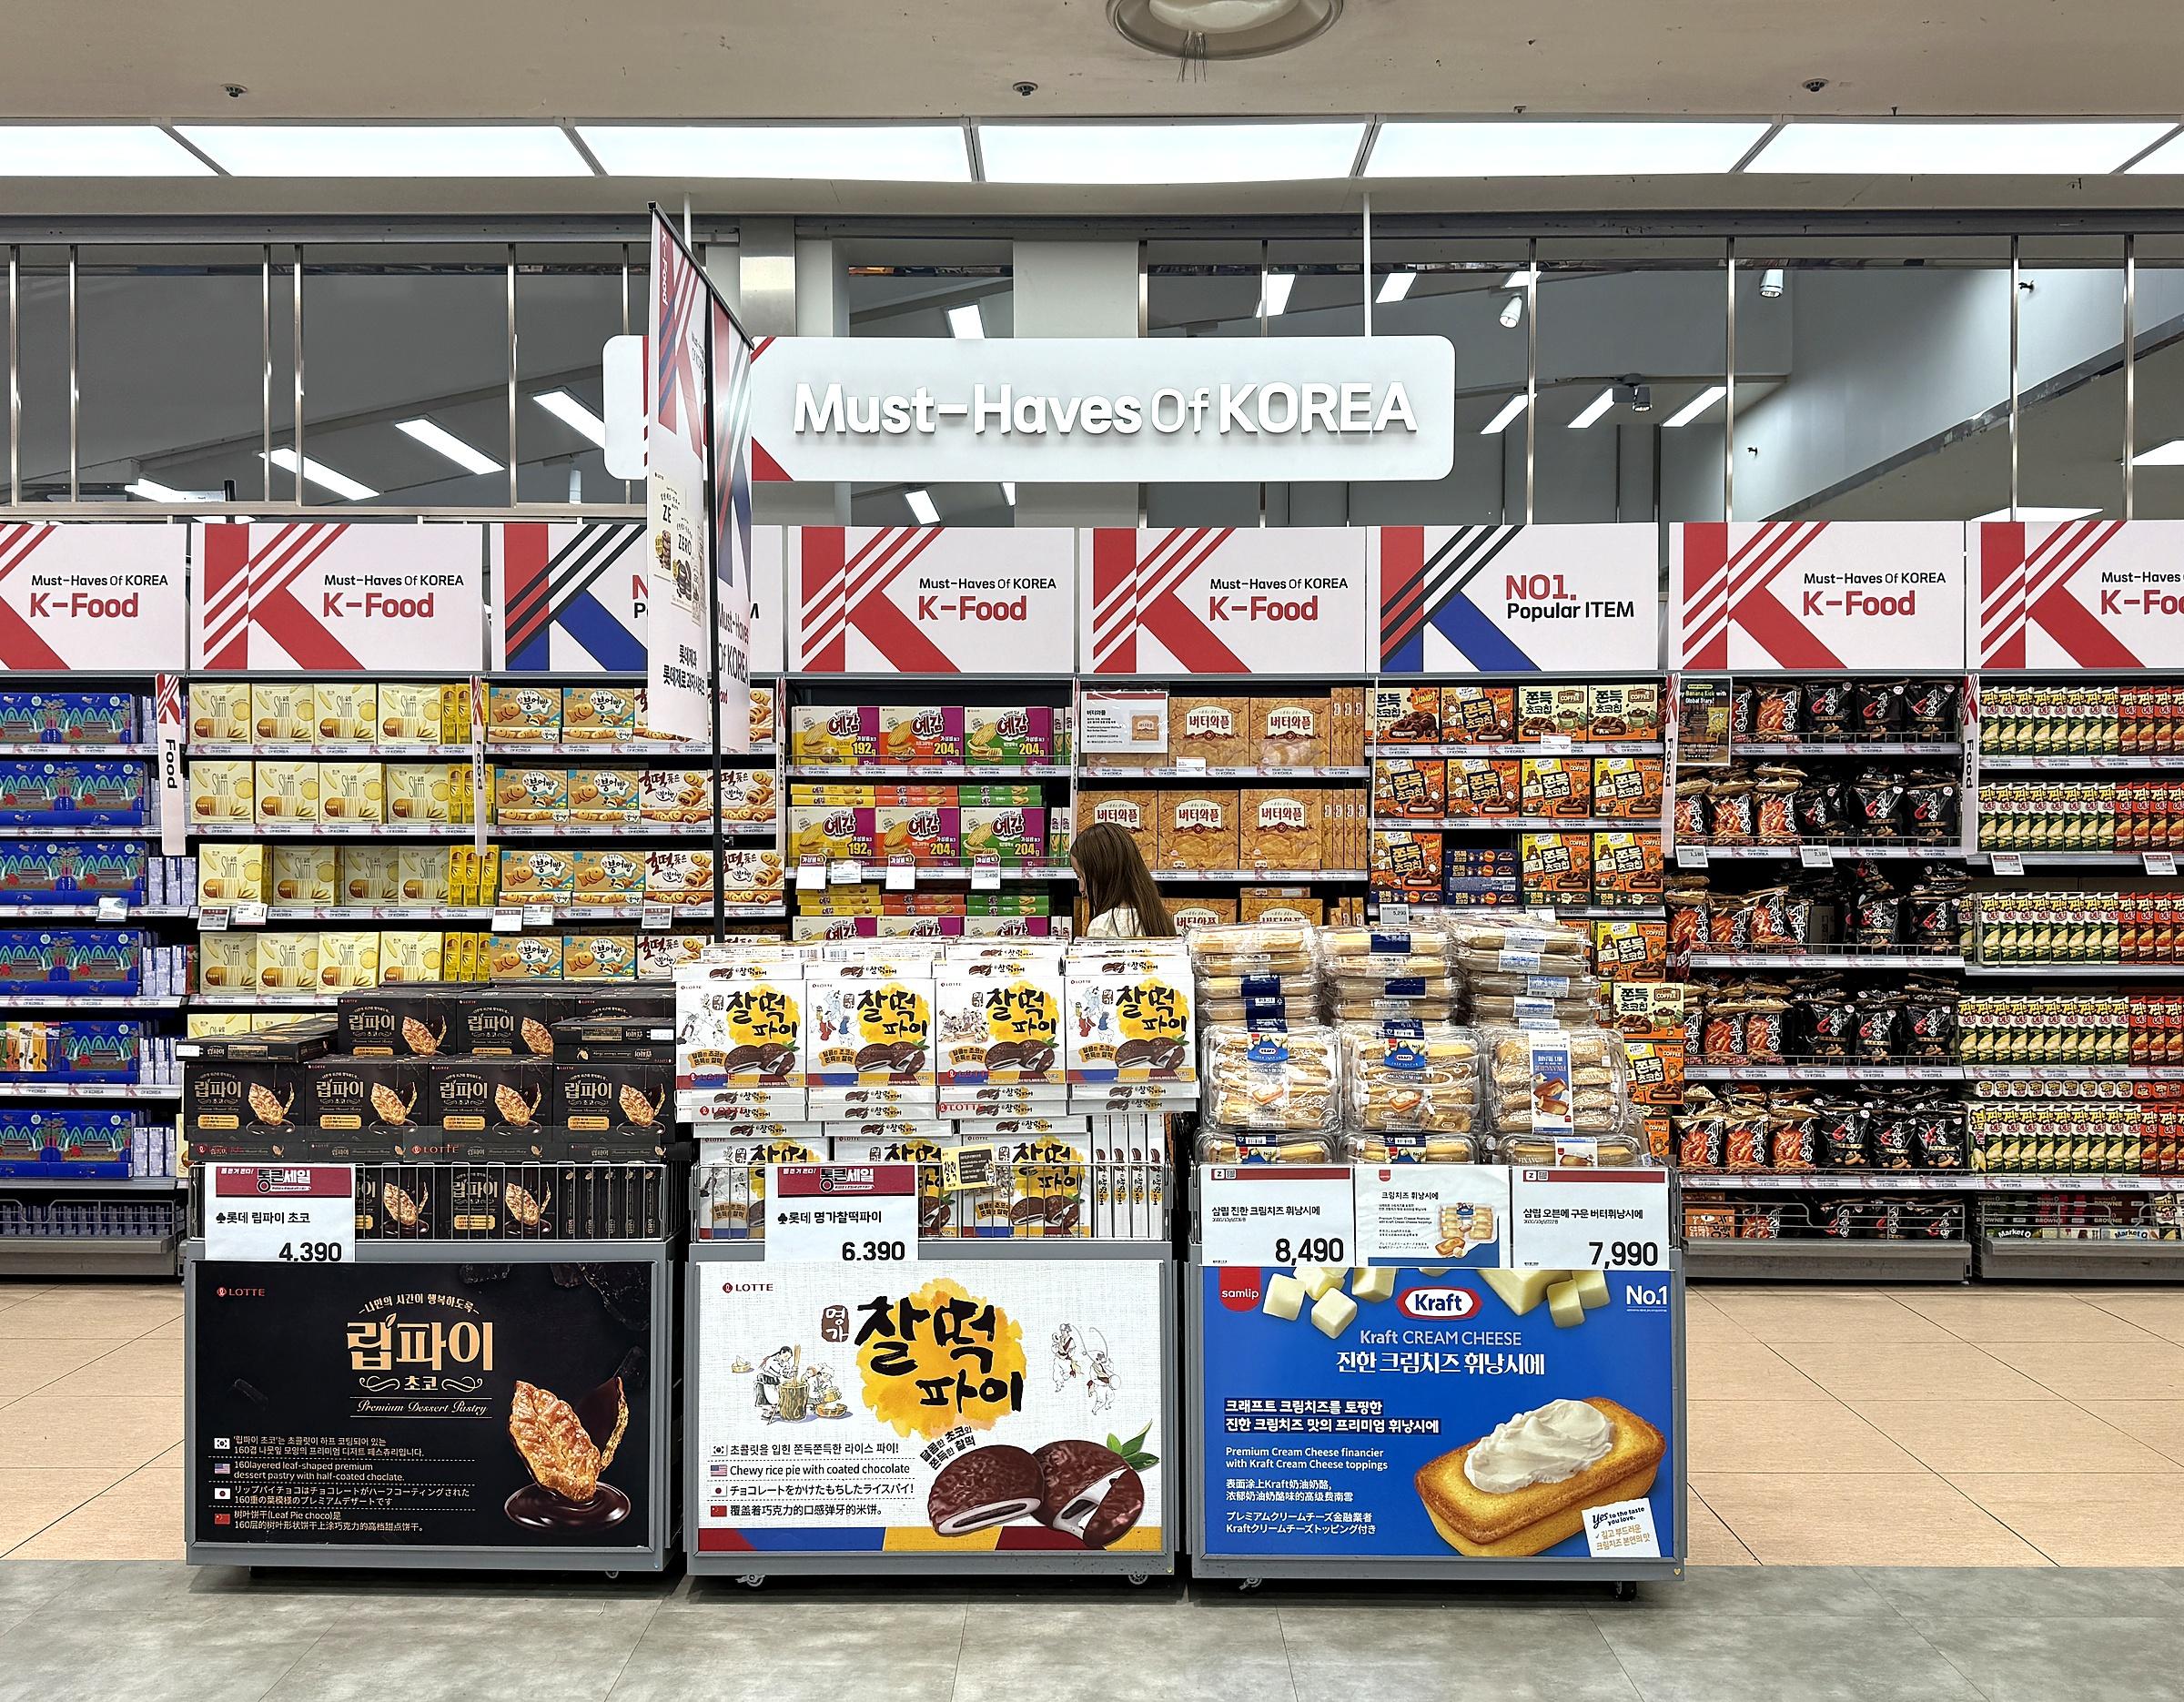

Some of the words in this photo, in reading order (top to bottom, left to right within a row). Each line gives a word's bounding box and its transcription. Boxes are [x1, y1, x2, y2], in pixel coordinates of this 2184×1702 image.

[793, 382, 1144, 435] Must-Haves
[1150, 387, 1211, 434] Of
[1218, 381, 1420, 434] KOREA
[31, 574, 107, 586] Must-Haves
[110, 574, 124, 586] Of
[125, 574, 168, 586] KOREA
[324, 574, 402, 586] Must-Haves
[404, 574, 418, 586] Of
[420, 574, 465, 586] KOREA
[918, 578, 996, 591] Must-Haves
[997, 578, 1011, 591] Of
[1012, 578, 1057, 591] KOREA
[1209, 578, 1287, 591] Must-Haves
[1289, 578, 1302, 591] Of
[1304, 578, 1349, 591] KOREA
[1804, 572, 1883, 584] Must-Haves
[1885, 572, 1899, 584] Of
[1901, 572, 1946, 584] KOREA
[2101, 571, 2181, 583] Must-Haves
[1505, 573, 1577, 601] NO1.
[30, 592, 139, 618] K-Food
[323, 592, 434, 618] K-Food
[918, 595, 1027, 622] K-Food
[1209, 595, 1318, 622] K-Food
[1803, 590, 1916, 616] K-Food
[1507, 602, 1581, 623] Popular
[1585, 601, 1634, 618] ITEM
[826, 714, 861, 735] 예감
[996, 714, 1030, 735] 예감
[1189, 714, 1230, 730] 버터와플
[853, 742, 876, 756] 192g
[165, 738, 178, 789] Food
[1664, 738, 1673, 788] Food
[1966, 738, 1974, 789] Food
[1178, 807, 1219, 822] 버터와플
[726, 989, 786, 1024] 찰떡
[349, 1014, 395, 1031] 립파이
[752, 1021, 798, 1038] 파이
[195, 1080, 241, 1098] 립파이
[288, 1212, 310, 1224] 초코
[1211, 1206, 1229, 1216] 삼립
[1230, 1206, 1249, 1216] 진한
[1249, 1206, 1285, 1216] 크림치즈
[1286, 1206, 1320, 1216] 휘낭시에
[1542, 1209, 1570, 1219] 오븐에
[1571, 1209, 1589, 1219] 구운
[1590, 1209, 1643, 1220] 버터휘낭시에
[1275, 1238, 1344, 1266] 8,490
[1588, 1241, 1658, 1269] 7,990
[228, 1288, 265, 1297] LOTTE
[735, 1282, 774, 1292] LOTTE
[1221, 1287, 1259, 1300] samlip
[1626, 1285, 1668, 1305] No.1
[396, 1293, 423, 1304] 시간이
[427, 1293, 475, 1312] 행복하도록
[1415, 1292, 1462, 1312] Kraft
[854, 1296, 996, 1376] 찰떡
[1360, 1330, 1399, 1344] Kraft
[1402, 1330, 1458, 1344] CREAM
[1461, 1331, 1522, 1346] CHEESE
[346, 1322, 493, 1371] 립파이
[1336, 1351, 1377, 1373] 진한
[1379, 1352, 1461, 1374] 크림치즈
[1463, 1352, 1545, 1375] 휘낭시에
[404, 1375, 439, 1390] 초코
[915, 1369, 1025, 1413] 파이
[357, 1399, 404, 1413] Premium
[408, 1401, 450, 1413] Dessert
[451, 1400, 488, 1416] Pastry
[1225, 1400, 1277, 1413] 크래프트
[1279, 1400, 1341, 1414] 크림치즈를
[1344, 1401, 1382, 1414] 토핑한
[1226, 1418, 1251, 1432] 진한
[1254, 1418, 1304, 1432] 크림치즈
[1307, 1419, 1332, 1432] 맛의
[1335, 1419, 1385, 1433] 프리미엄
[1388, 1420, 1439, 1434] 휘낭시에
[730, 1444, 769, 1455] 초콜릿을
[772, 1444, 791, 1455] 입힌
[794, 1444, 842, 1455] 쫀득쫀득한
[845, 1443, 874, 1454] 라이스
[876, 1443, 899, 1454] 파이!
[1226, 1447, 1269, 1456] Premium
[1271, 1447, 1302, 1457] Cream
[1305, 1447, 1339, 1457] Cheese
[1341, 1447, 1383, 1458] financier
[234, 1461, 281, 1471] 160layered
[282, 1461, 333, 1472] leaf-shaped
[335, 1462, 373, 1472] premium
[730, 1465, 763, 1477] Chewy
[765, 1464, 784, 1475] rice
[785, 1464, 801, 1477] pie
[803, 1464, 824, 1475] with
[826, 1464, 860, 1474] coated
[862, 1464, 910, 1474] chocolate
[1226, 1459, 1247, 1468] with
[1249, 1459, 1274, 1468] Kraft
[1276, 1460, 1307, 1469] Cream
[1309, 1460, 1343, 1470] Cheese
[1346, 1461, 1388, 1472] toppings
[234, 1471, 266, 1479] dessert
[268, 1473, 295, 1482] pastry
[297, 1472, 315, 1480] with
[317, 1472, 365, 1480] half-coated
[290, 1511, 307, 1519] Pie
[1607, 1518, 1620, 1526] you
[1643, 1533, 1651, 1543] 맛
